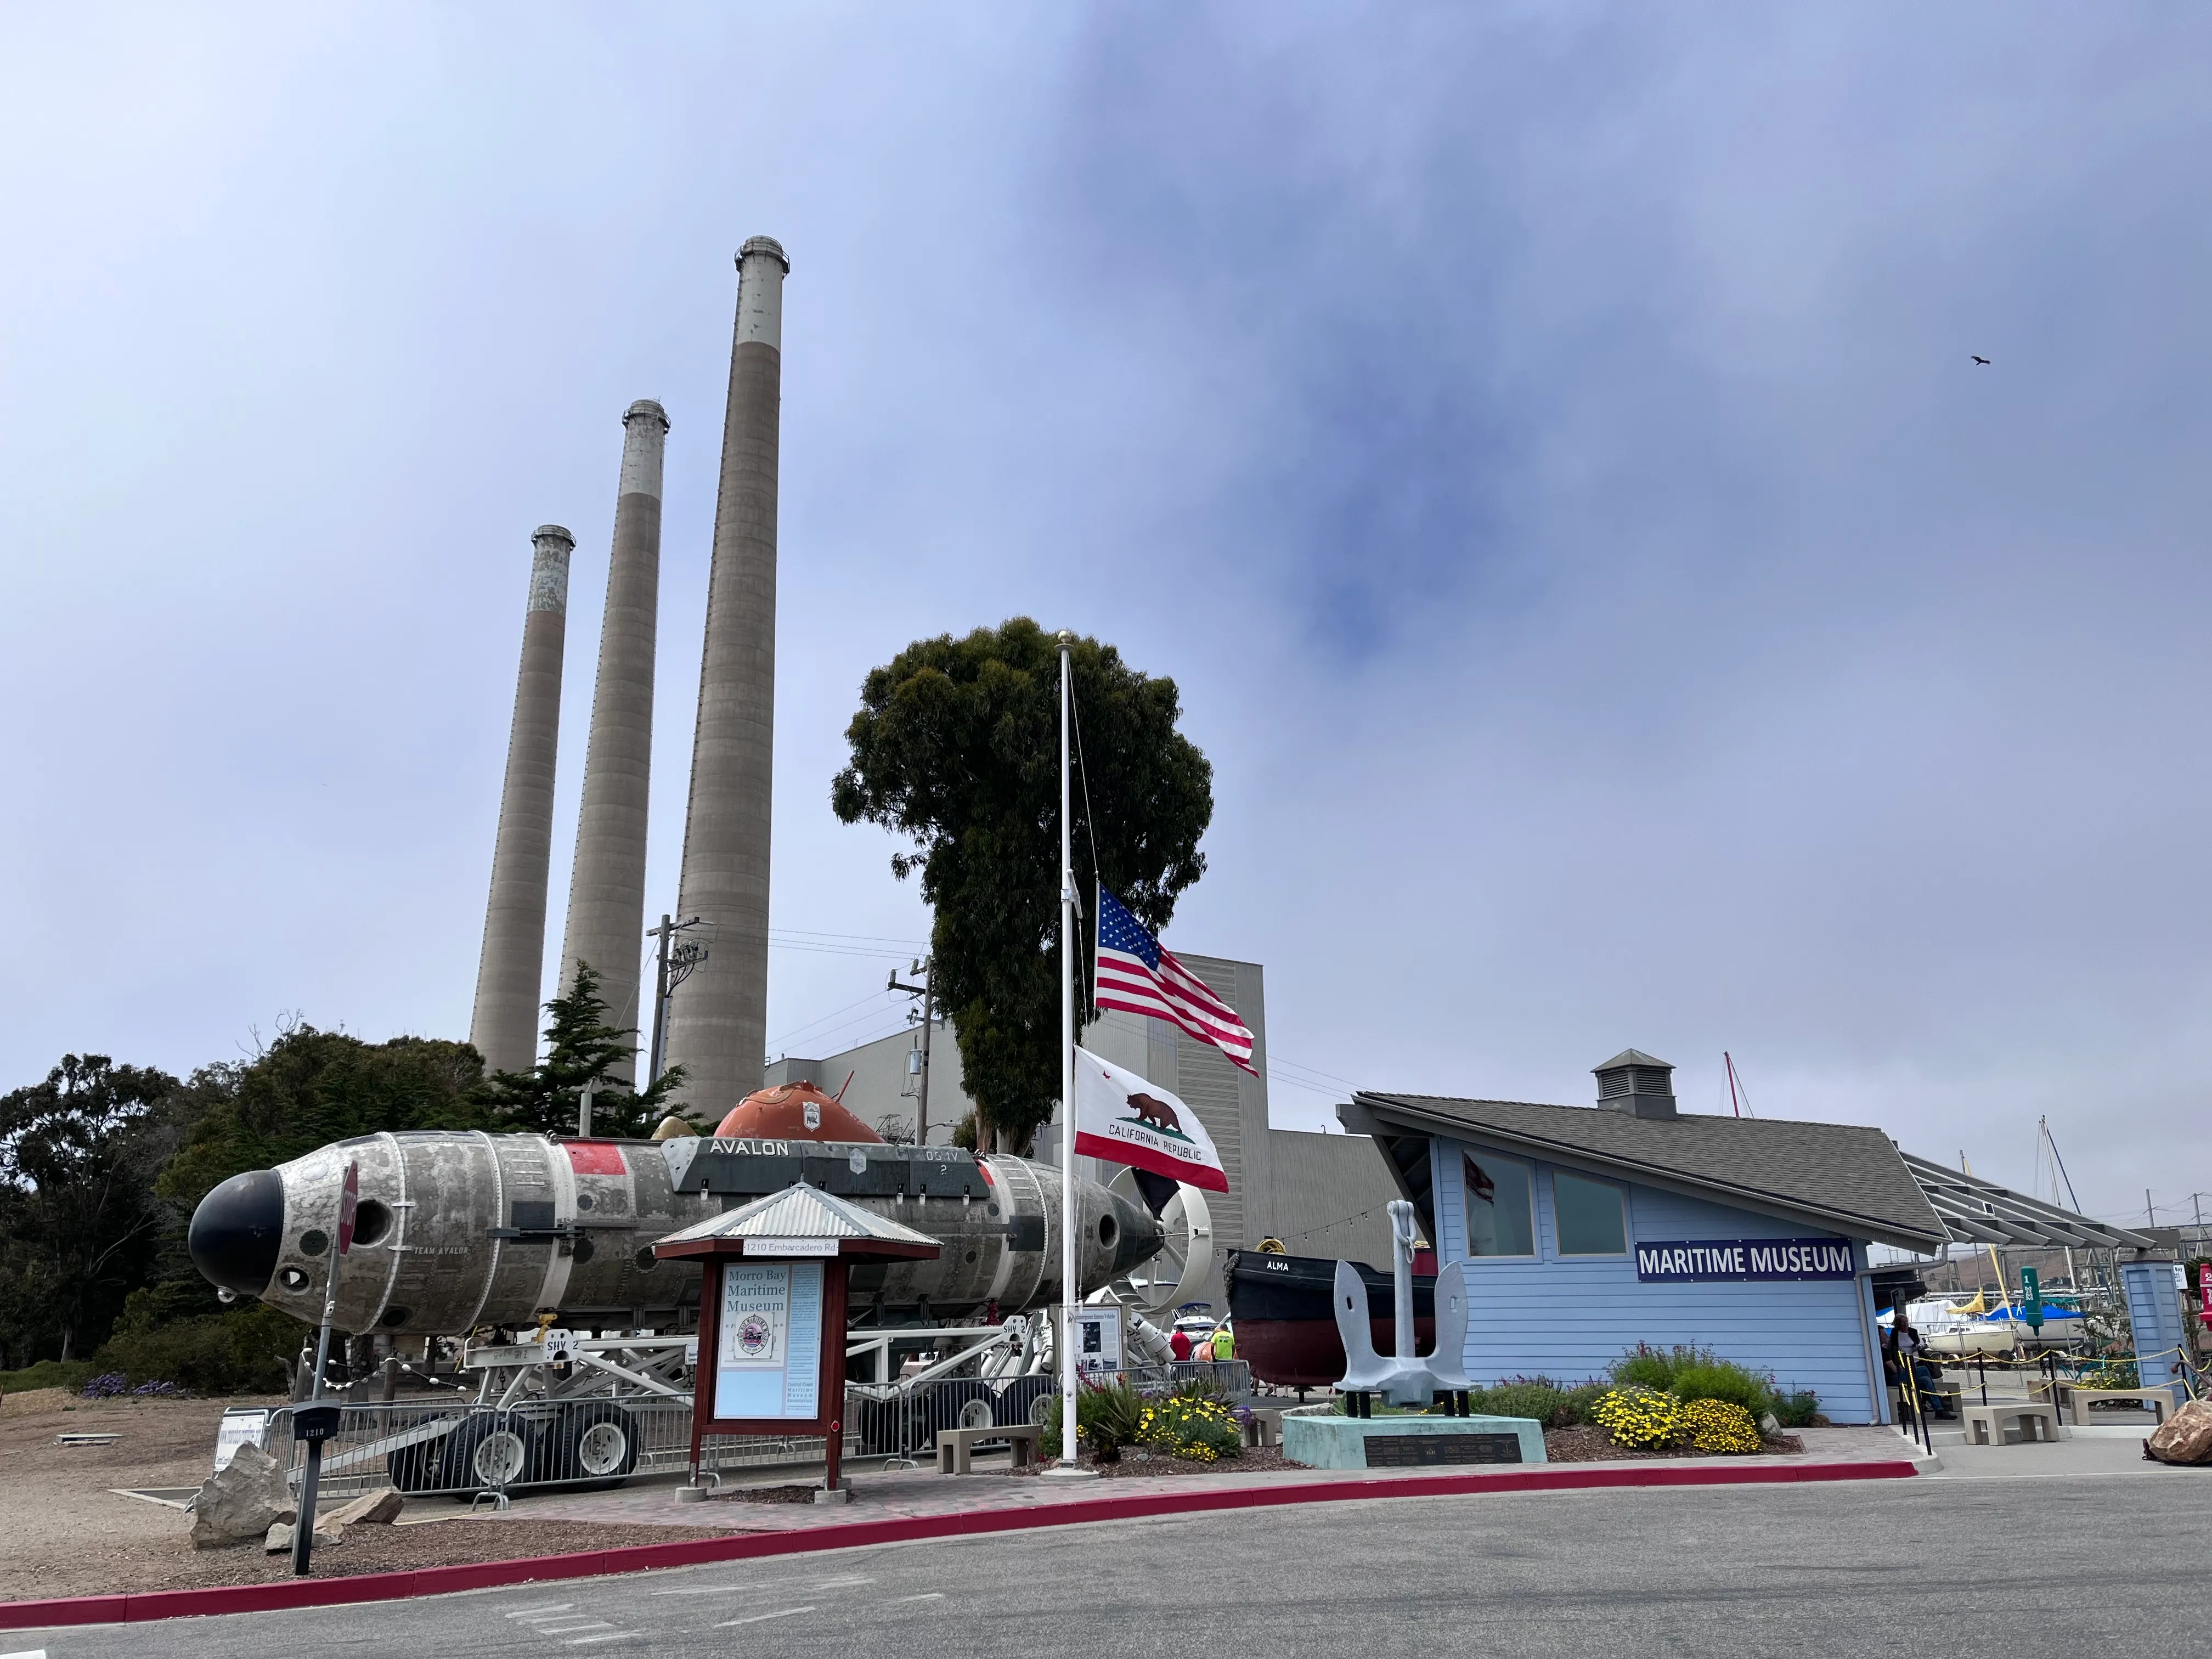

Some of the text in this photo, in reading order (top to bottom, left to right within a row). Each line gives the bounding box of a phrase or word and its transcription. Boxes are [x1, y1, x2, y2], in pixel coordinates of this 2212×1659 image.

[709, 1139, 790, 1156] AVALON
[1109, 1124, 1202, 1161] CALIFORNIA REPUBLIC
[341, 1190, 357, 1226] STOP
[414, 1246, 468, 1255] TEAM AVALON
[746, 1243, 837, 1252] 1210 Embarcadero Rd.
[1638, 1245, 1852, 1274] MARITIME MUSEUM
[1267, 1260, 1289, 1272] ALMA
[729, 1270, 787, 1282] Morro Bay
[2023, 1275, 2030, 1283] 1
[727, 1284, 786, 1296] Maritime
[726, 1300, 784, 1312] Museum
[548, 1340, 579, 1351] SHV 2
[306, 1427, 324, 1437] 1210
